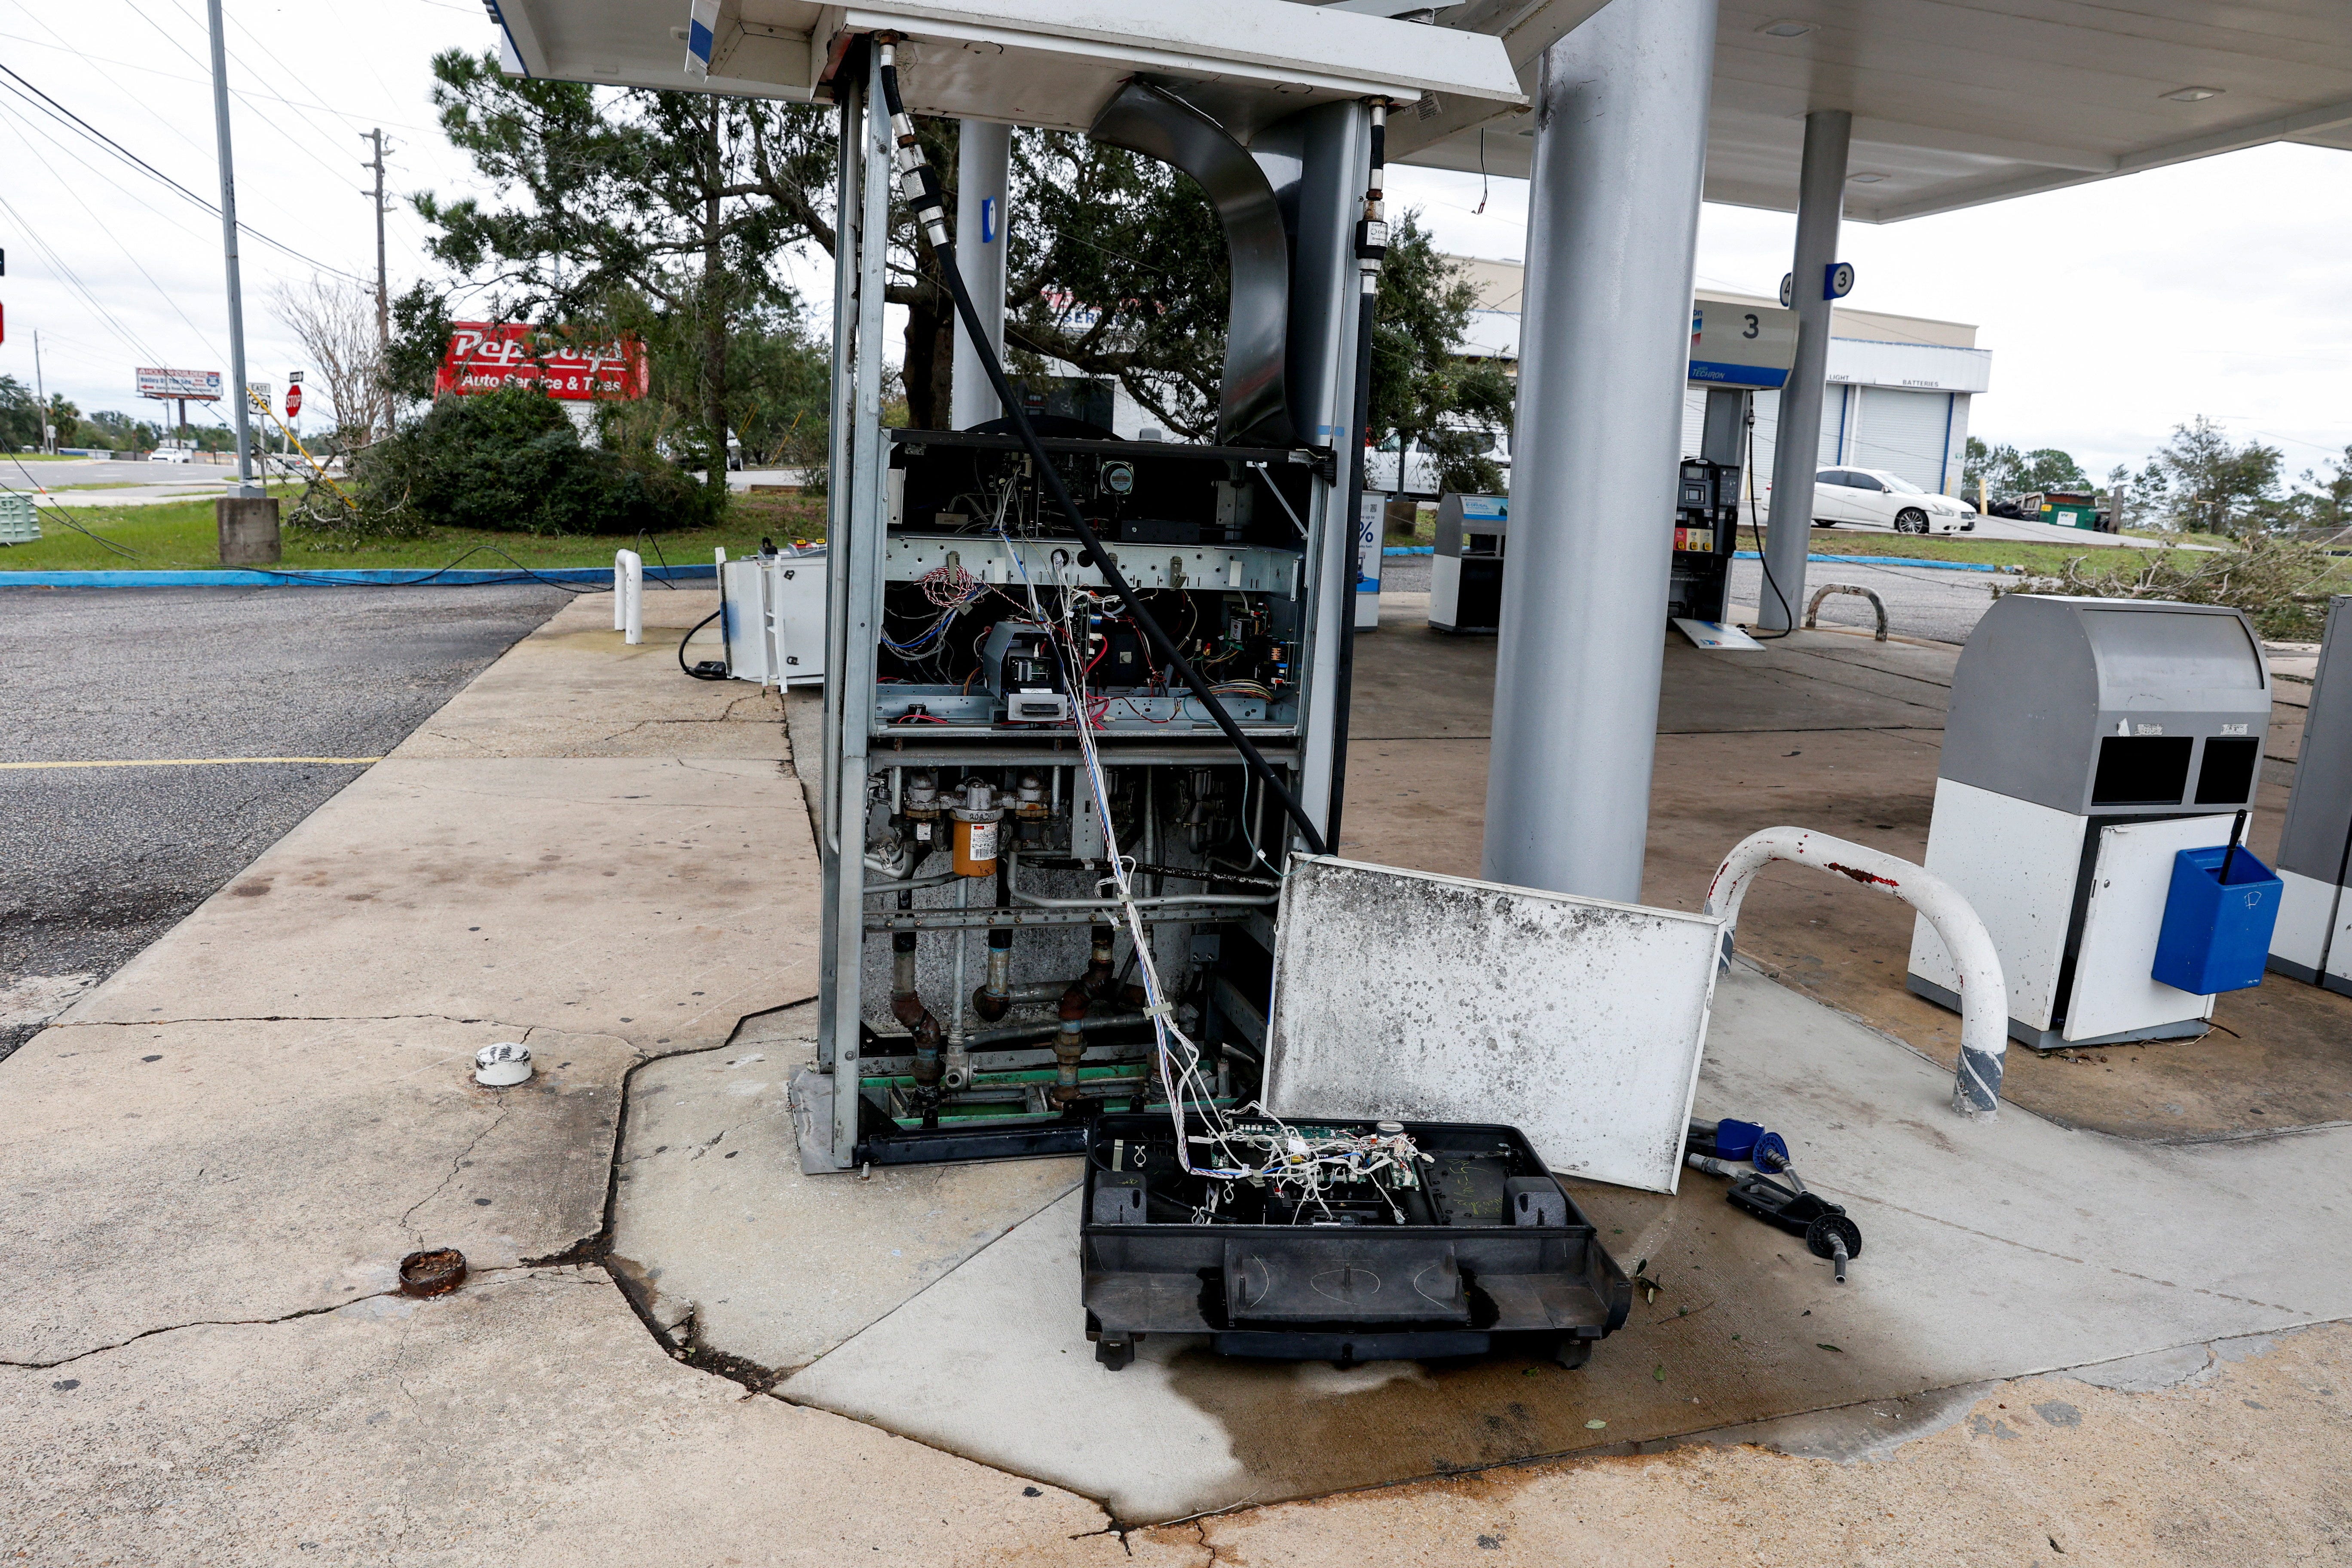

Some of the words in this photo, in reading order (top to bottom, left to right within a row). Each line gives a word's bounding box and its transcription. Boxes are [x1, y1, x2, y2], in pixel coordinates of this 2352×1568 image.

[990, 206, 993, 226] 7
[1838, 271, 1847, 288] 3
[1785, 281, 1791, 296] 4
[1743, 314, 1759, 339] 3
[453, 330, 525, 365] Pep
[461, 373, 500, 388] Auto
[504, 373, 563, 390] Serice
[567, 376, 579, 391] &
[1692, 368, 1726, 380] TECHRON
[286, 395, 301, 408] STOP
